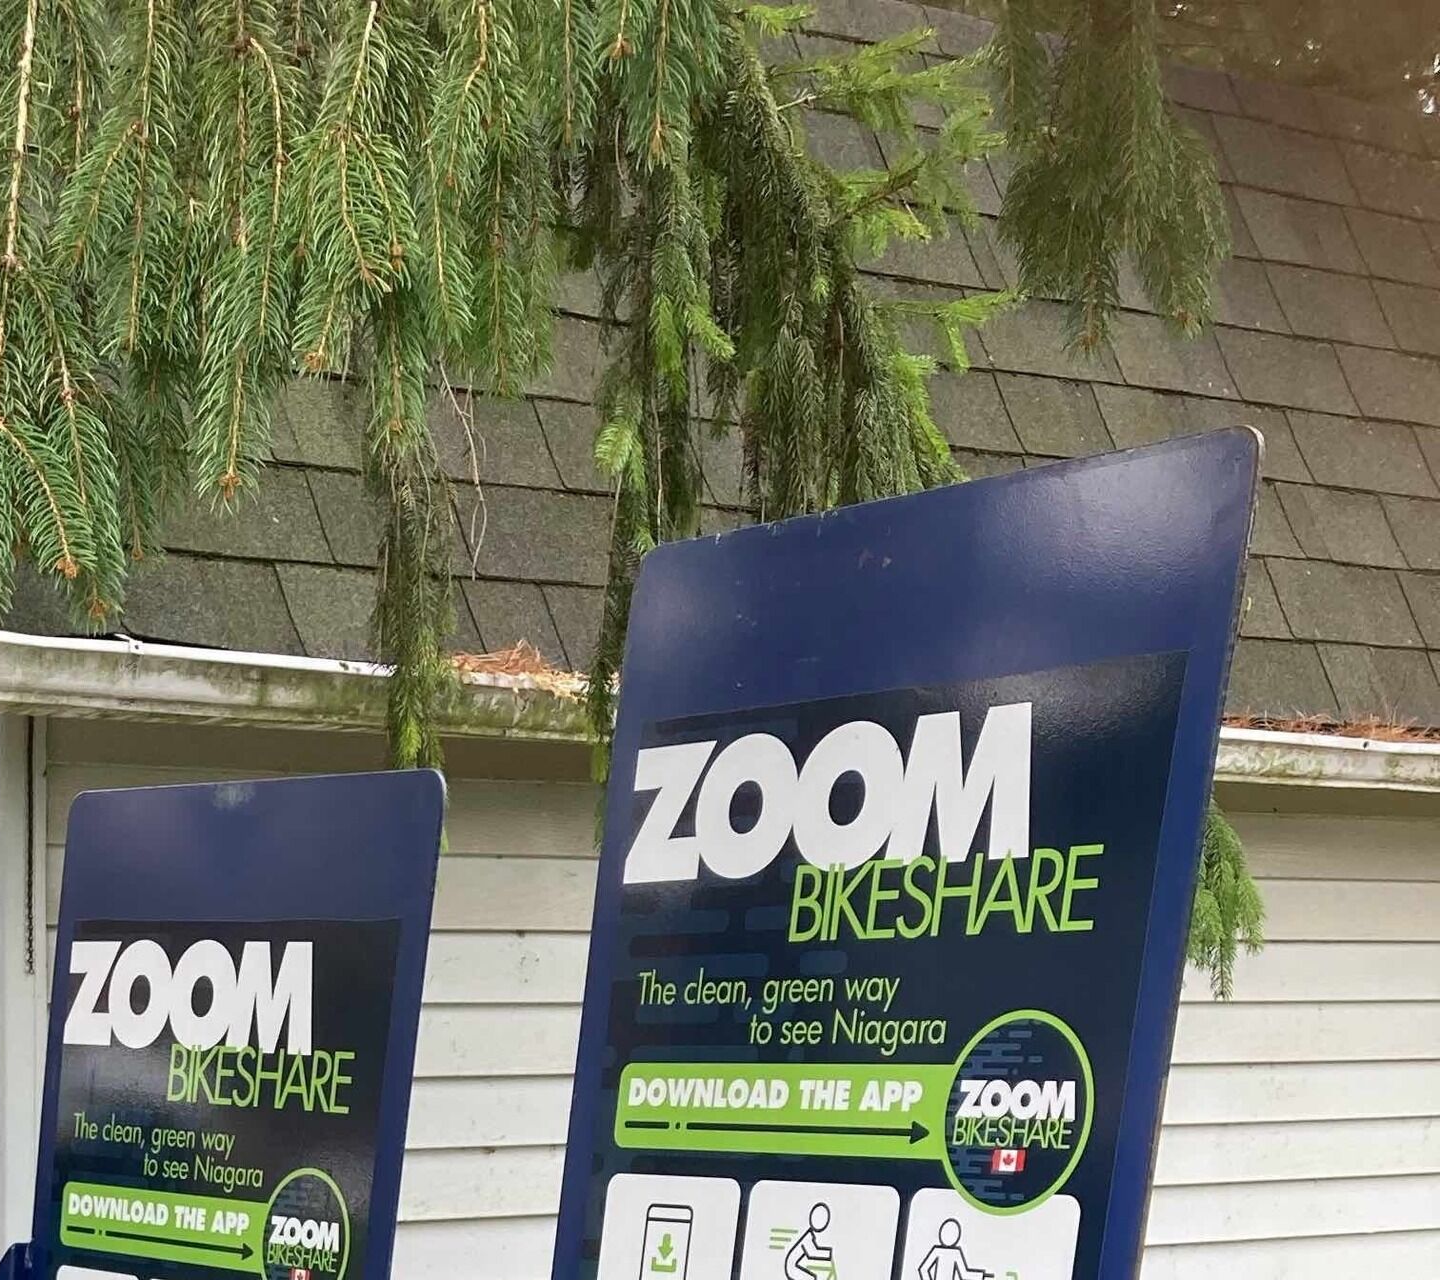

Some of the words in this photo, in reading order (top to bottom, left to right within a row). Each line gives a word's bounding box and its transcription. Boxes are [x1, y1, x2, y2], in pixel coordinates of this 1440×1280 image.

[623, 702, 1032, 884] ZOOM
[788, 843, 1104, 943] BIKESHARE
[62, 939, 313, 1056] ZOOM
[638, 971, 677, 1005] The
[684, 968, 753, 1011] clean,
[763, 976, 834, 1014] green
[845, 975, 901, 1012] way
[749, 1015, 773, 1045] to
[781, 1022, 823, 1045] see
[831, 1009, 947, 1056] Niagara
[166, 1043, 356, 1115] BIKESHARE
[628, 1078, 790, 1110] DOWNLOAD
[799, 1079, 850, 1111] THE
[860, 1081, 923, 1112] APP
[954, 1079, 1076, 1121] ZOOM
[73, 1112, 98, 1141] The
[102, 1114, 145, 1147] clean,
[151, 1127, 195, 1154] green
[201, 1131, 236, 1160] way
[952, 1116, 1072, 1150] BIKESHARE
[143, 1153, 158, 1177] to
[163, 1159, 189, 1181] see
[193, 1155, 264, 1194] Niagara
[67, 1193, 169, 1227] DOWNLOAD
[174, 1205, 206, 1232] THE
[211, 1210, 250, 1237] APP
[268, 1215, 339, 1253] ZOOM
[266, 1241, 337, 1273] BIKESHARE
